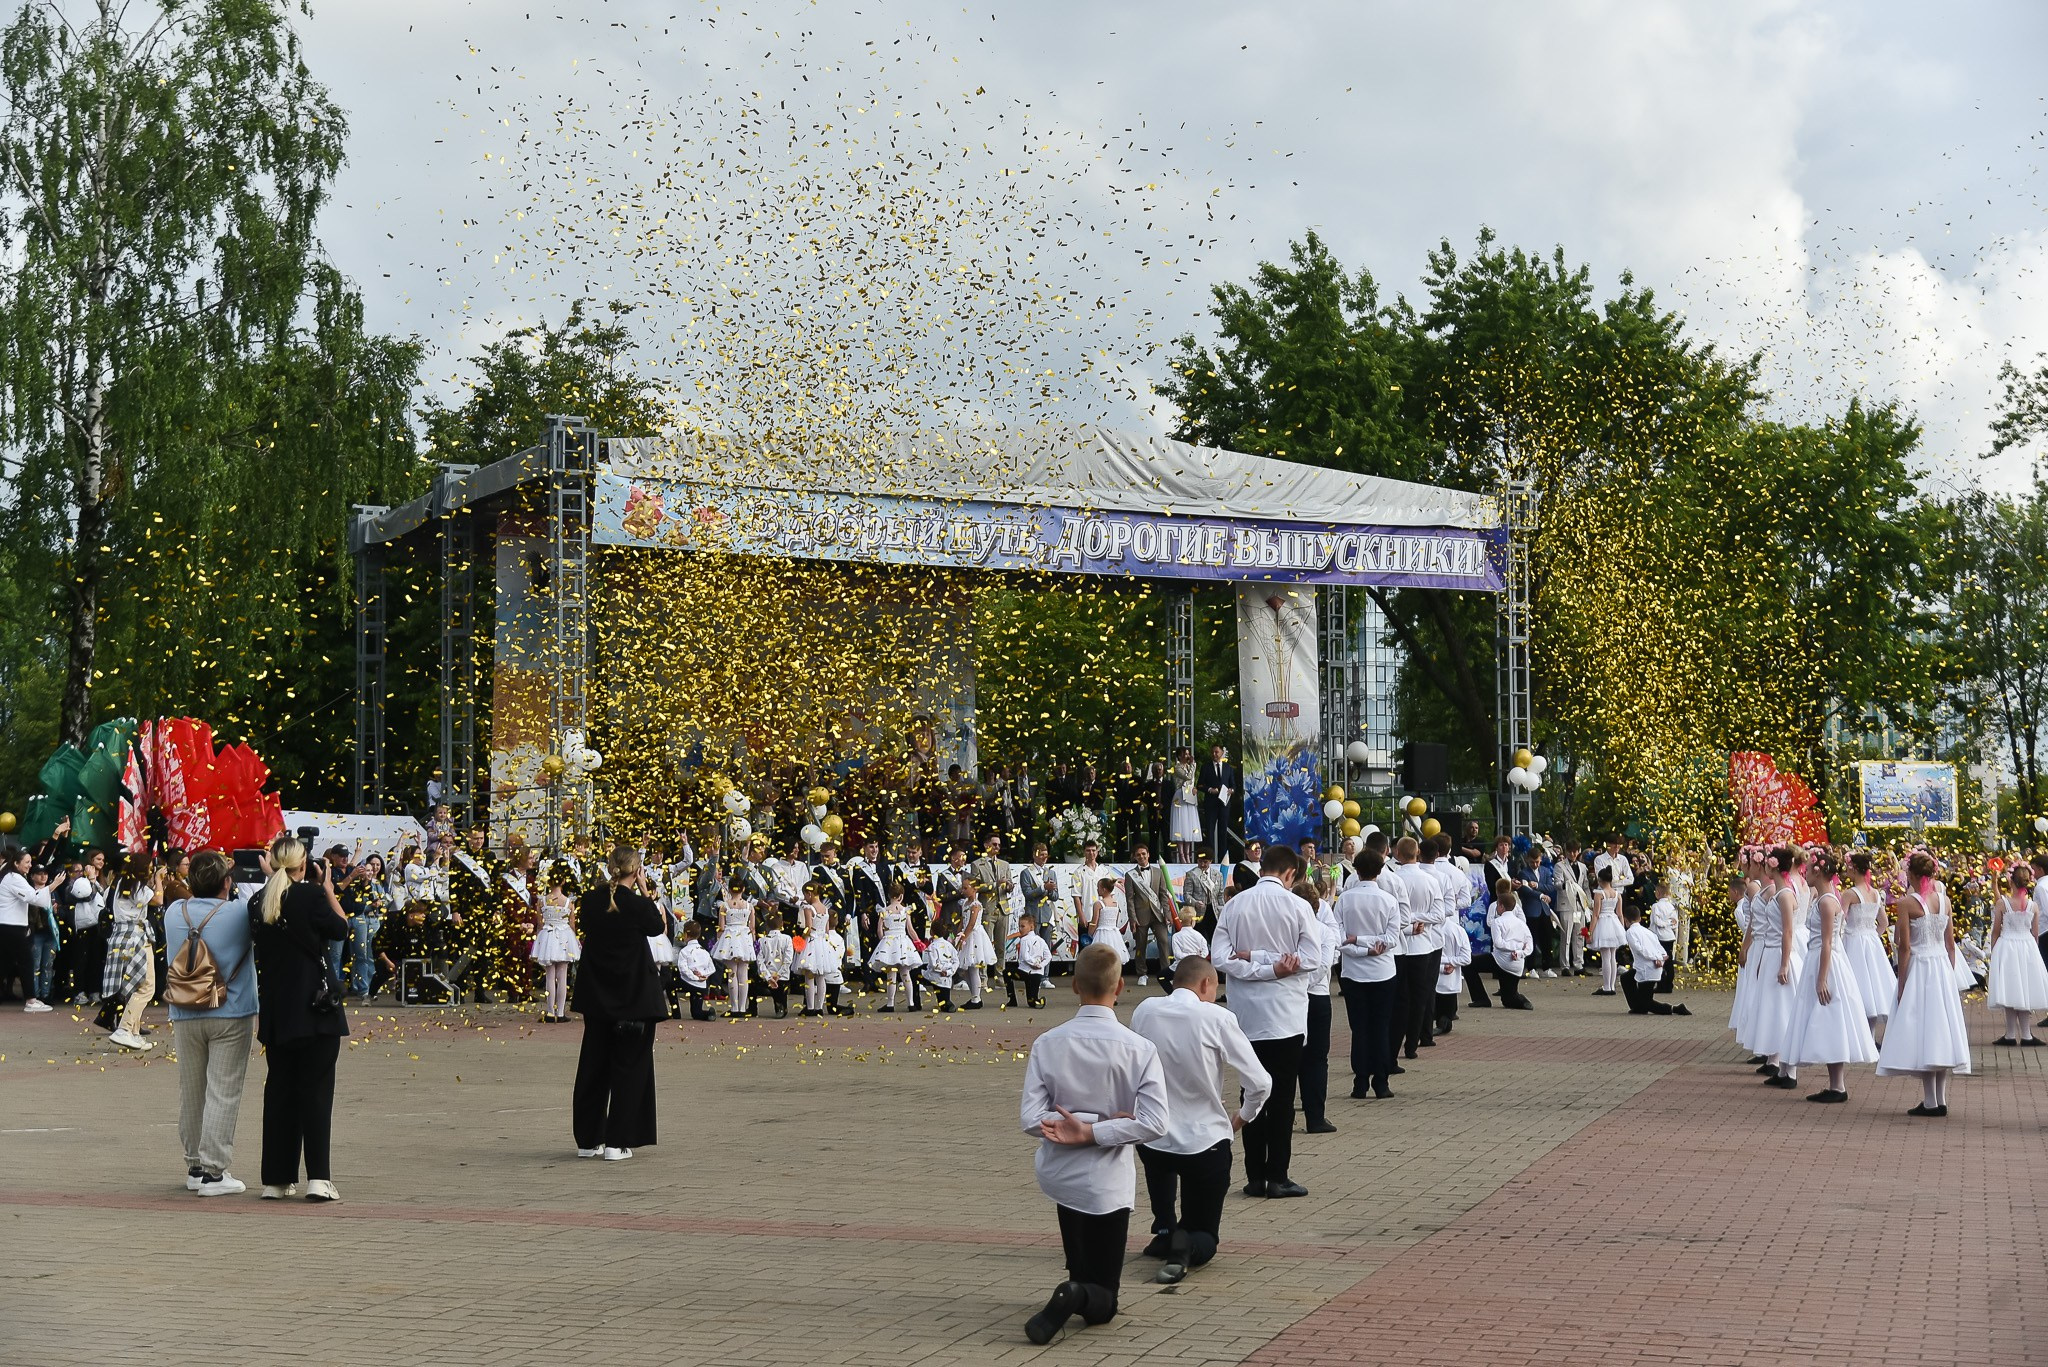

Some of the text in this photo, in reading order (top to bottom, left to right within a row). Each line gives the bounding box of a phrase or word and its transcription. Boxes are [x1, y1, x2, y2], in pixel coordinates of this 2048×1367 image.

[748, 499, 780, 538] В
[783, 504, 944, 556] добрый
[1050, 516, 1229, 566] ДОРОГИЕ
[1231, 526, 1487, 577] ВЫПУСКНИКИ!
